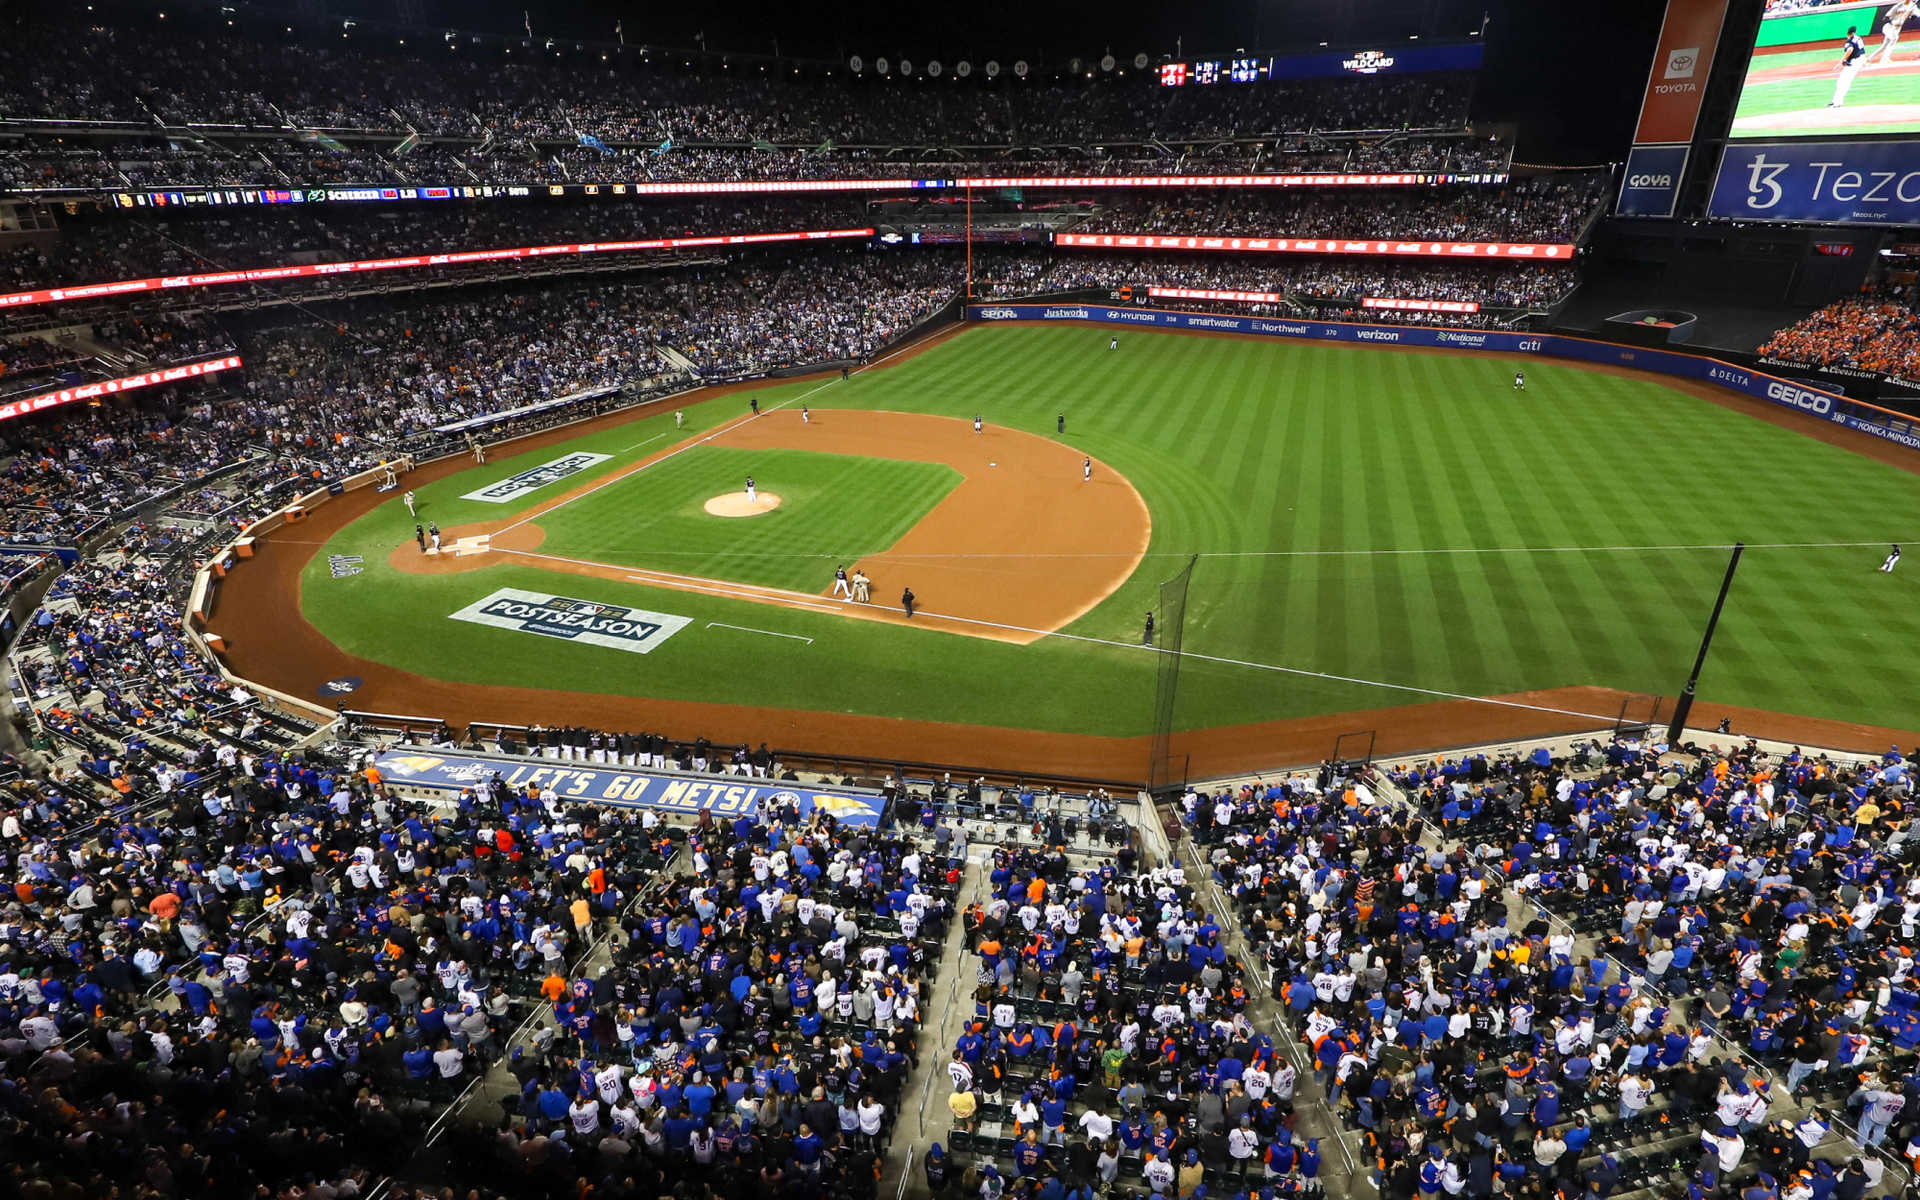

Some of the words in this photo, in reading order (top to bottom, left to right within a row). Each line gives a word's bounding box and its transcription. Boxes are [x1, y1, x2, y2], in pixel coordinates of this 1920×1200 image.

[1137, 57, 1145, 65] 42
[1343, 60, 1366, 69] WILD
[1367, 58, 1394, 67] CARD
[931, 64, 939, 72] 31
[960, 64, 968, 72] 41
[1017, 64, 1025, 72] 37
[1655, 83, 1696, 94] TOYOTA
[1630, 175, 1671, 187] GOYA
[328, 190, 379, 200] SCHERZER
[162, 277, 190, 288] Coca-Cola
[192, 273, 237, 283] CELEBRATING
[65, 286, 107, 297] HOMETOWN
[1044, 308, 1088, 317] Justworks
[1121, 313, 1155, 321] HYUNDAI
[1188, 317, 1239, 328] smartwater
[1262, 323, 1306, 334] Northwell
[1357, 330, 1399, 341] verizon
[1447, 333, 1485, 343] National
[1519, 340, 1541, 351] citi
[1620, 352, 1634, 360] 408
[203, 361, 224, 372] Coca-Cola
[1789, 362, 1811, 370] LIGHT
[164, 369, 187, 381] Coca-Cola
[1719, 371, 1748, 386] DELTA
[1853, 370, 1877, 380] LIGHT
[122, 377, 146, 389] Coca-Cola
[75, 385, 102, 398] Coca-Cola
[33, 395, 57, 409] Coca-Cola
[1768, 382, 1831, 414] GEICO
[1832, 413, 1845, 423] 380
[1858, 422, 1886, 437] KONICA
[1887, 430, 1920, 448] MINOLTA
[488, 601, 654, 639] POSTSEASON
[505, 765, 596, 795] LET'S
[603, 776, 650, 800] GO
[658, 782, 758, 811] METS!
[299, 918, 308, 927] 12
[1315, 1023, 1328, 1033] 57
[602, 1080, 616, 1090] 20
[1883, 1104, 1899, 1112] 48
